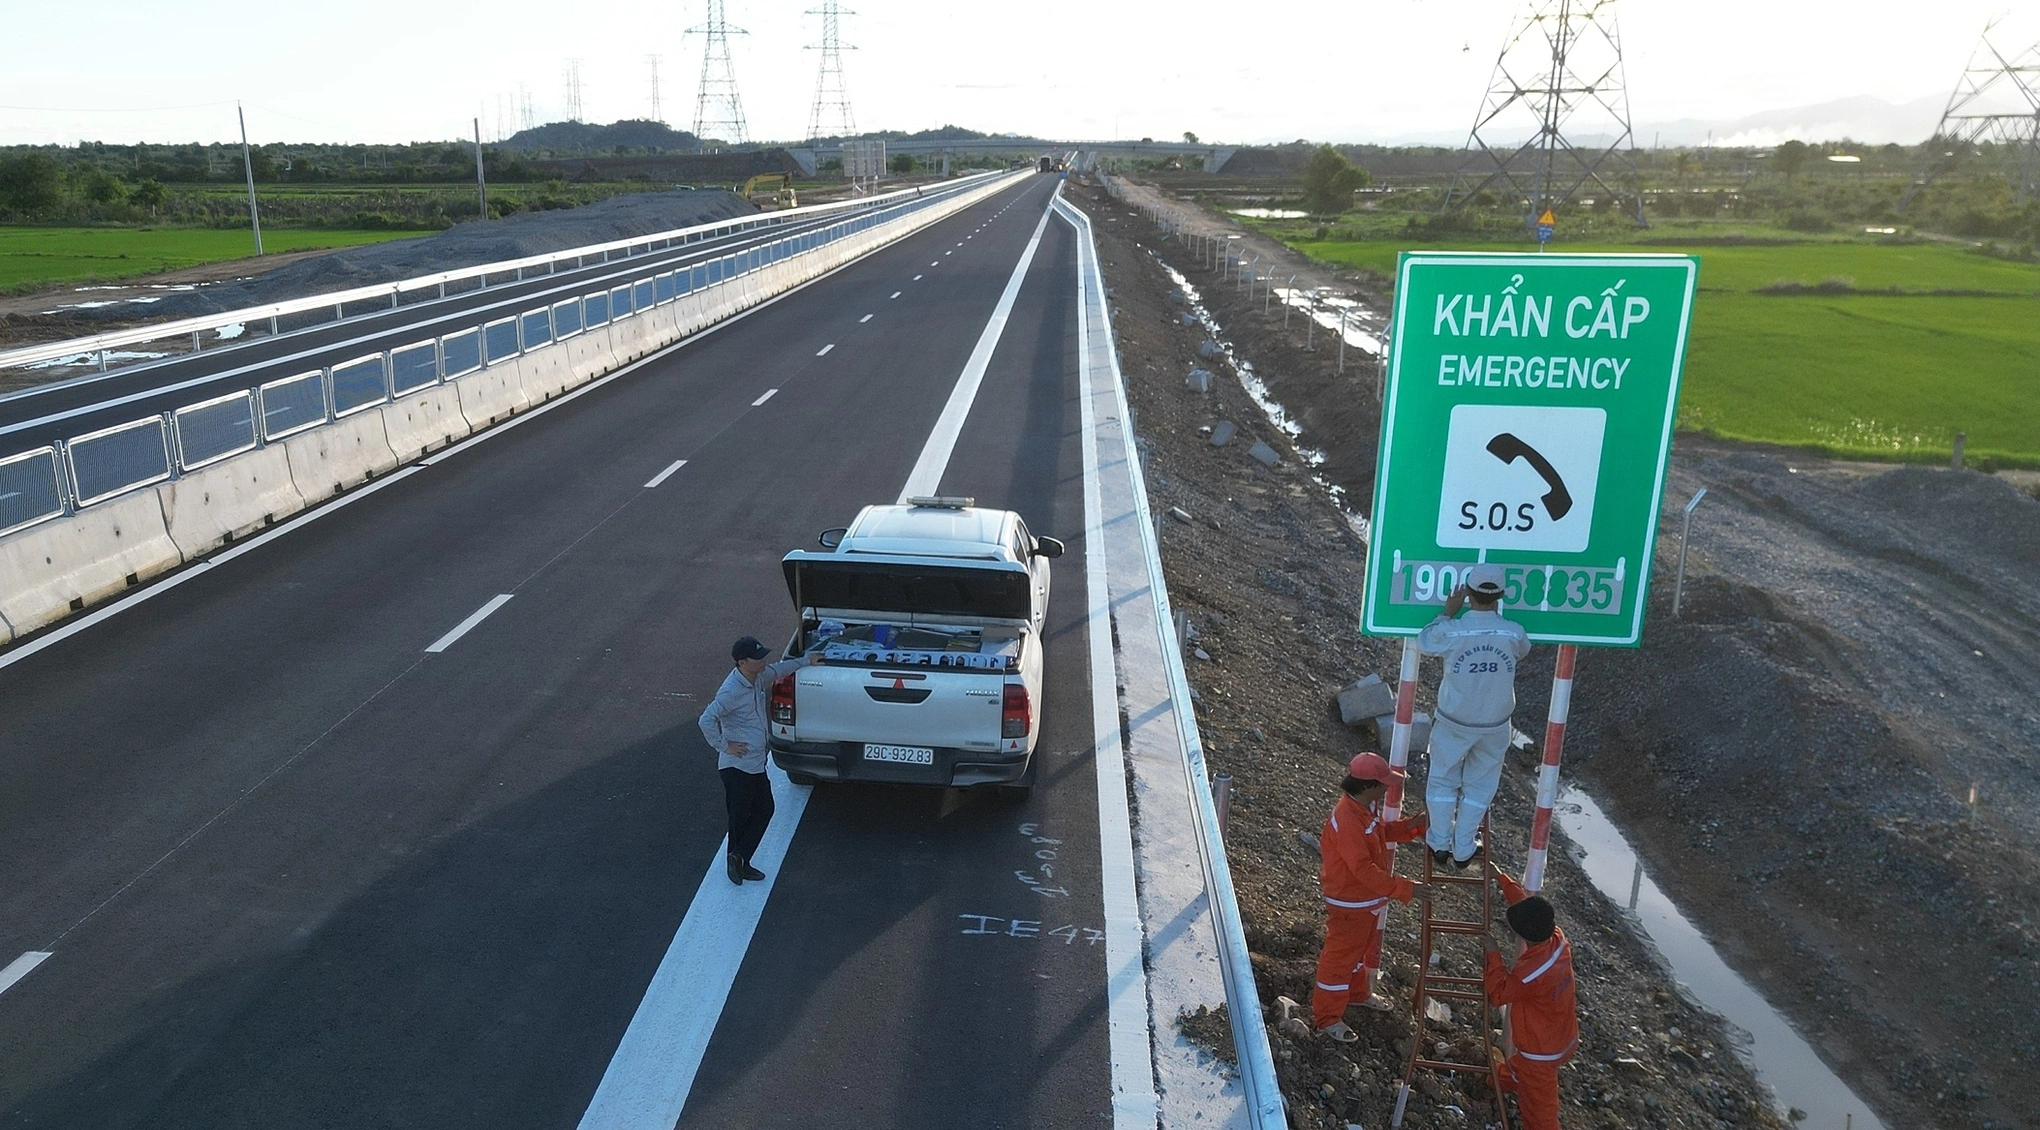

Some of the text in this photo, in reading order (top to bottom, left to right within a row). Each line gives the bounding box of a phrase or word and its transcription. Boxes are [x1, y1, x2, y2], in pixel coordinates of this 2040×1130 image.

[1433, 273, 1650, 339] KHẨN CẤP
[1438, 354, 1631, 389] EMERGENCY
[1458, 501, 1535, 532] S.O.S
[1469, 662, 1498, 673] 238
[865, 745, 932, 764] 29C-932.83
